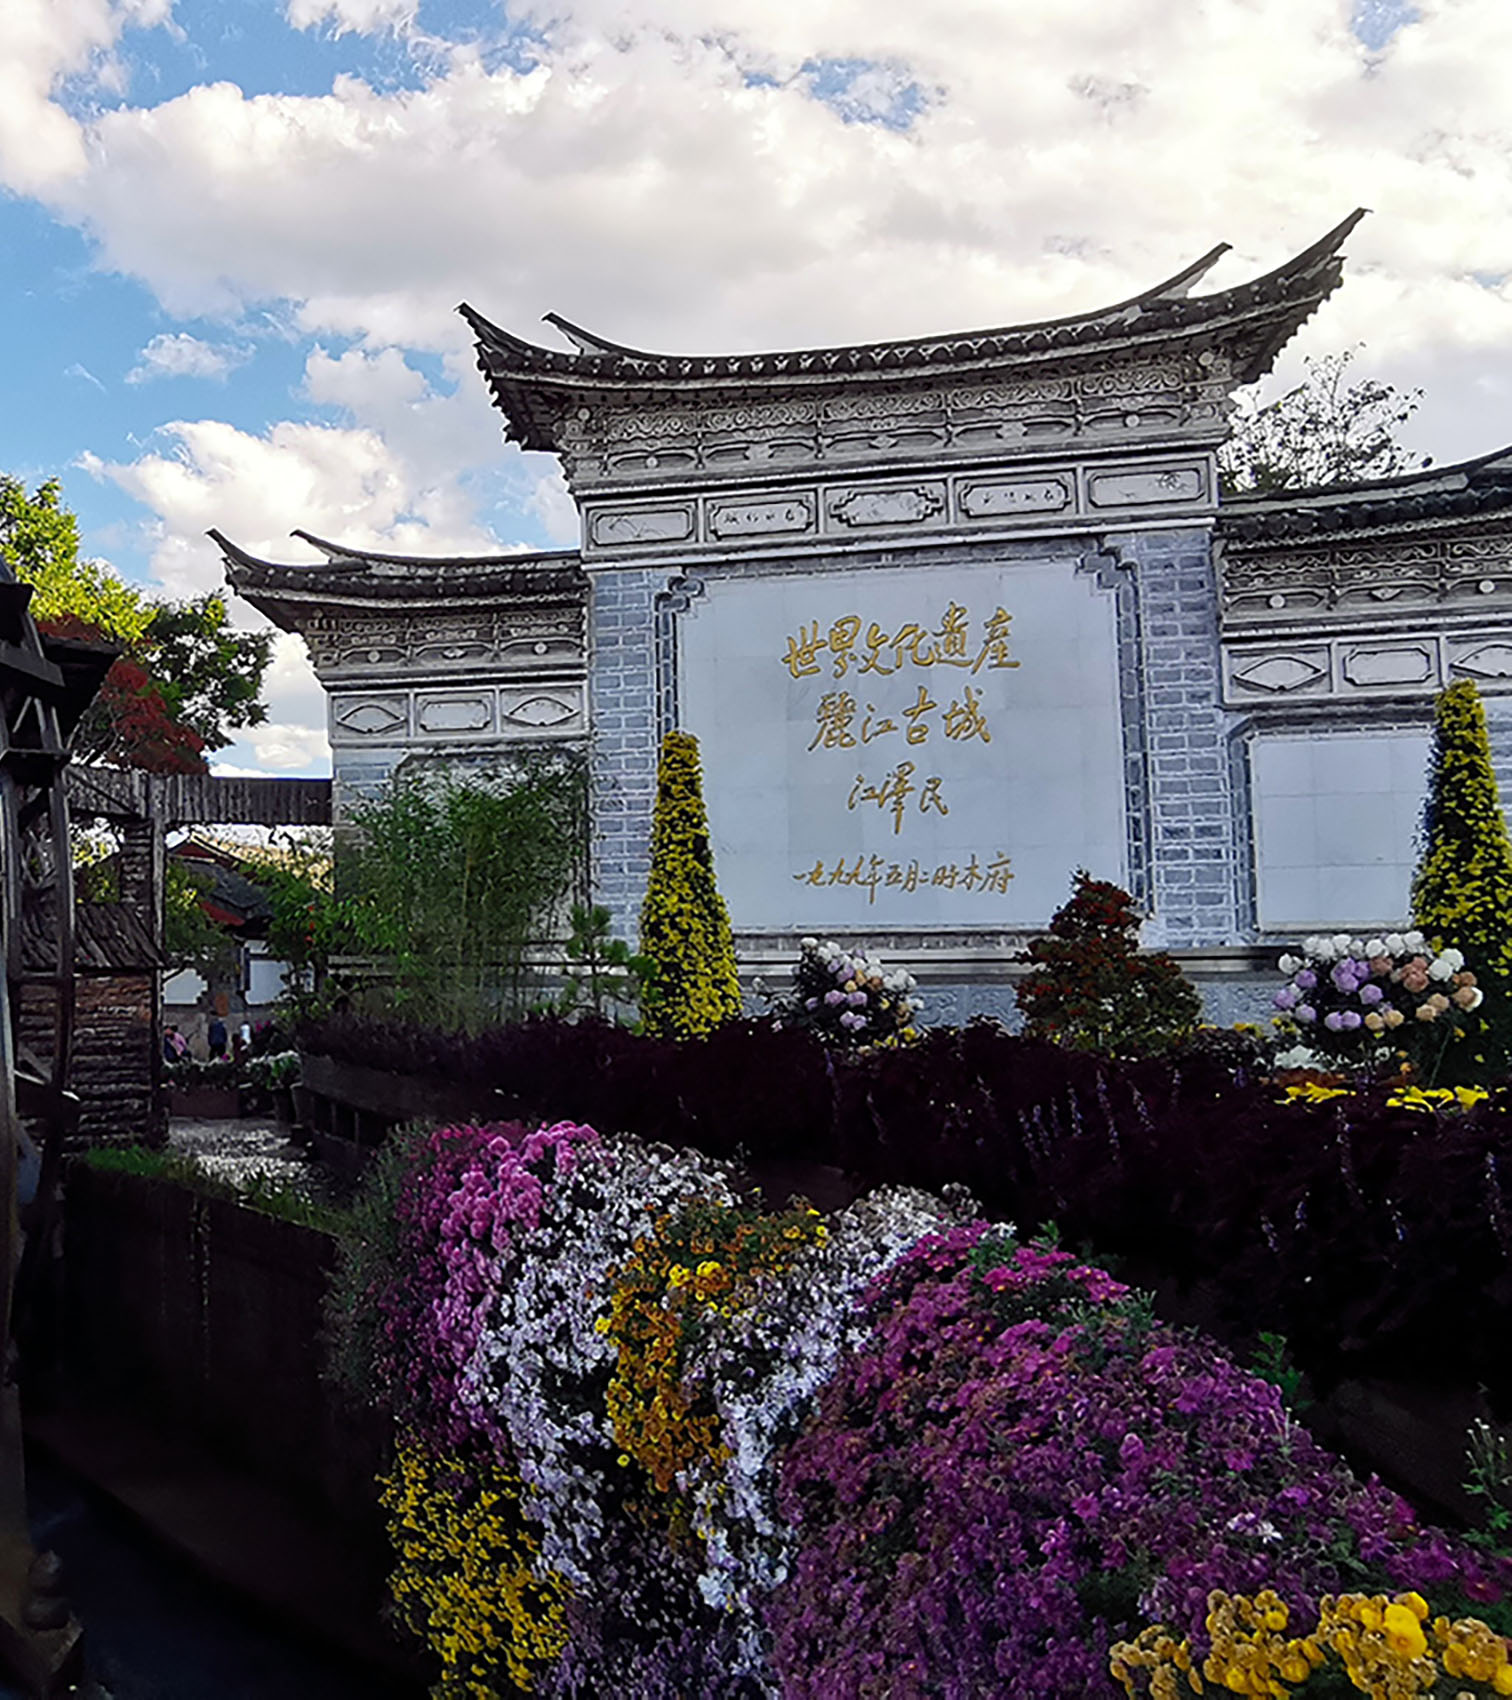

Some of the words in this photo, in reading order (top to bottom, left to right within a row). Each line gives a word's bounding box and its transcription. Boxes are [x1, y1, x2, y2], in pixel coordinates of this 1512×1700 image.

[807, 685, 991, 752] 麗江古城
[846, 761, 949, 835] 江澤民
